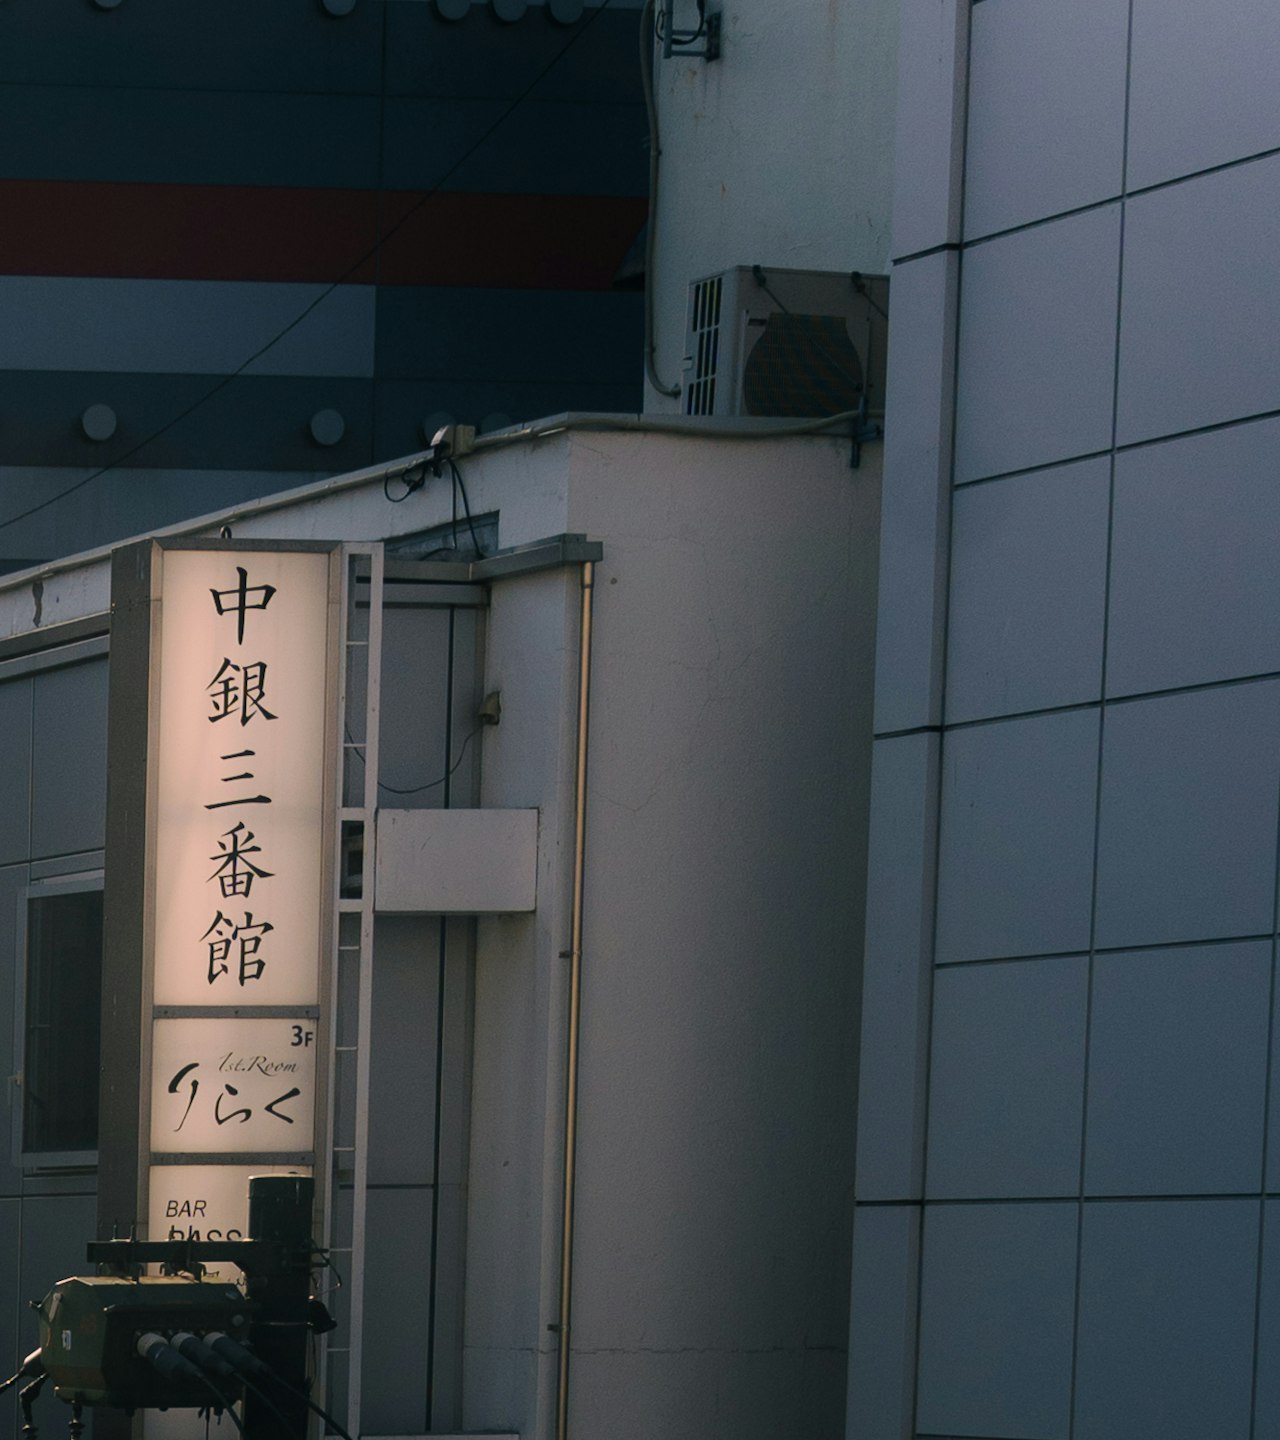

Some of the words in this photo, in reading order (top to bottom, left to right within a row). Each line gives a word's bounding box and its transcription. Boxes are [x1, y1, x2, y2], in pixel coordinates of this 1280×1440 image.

[198, 566, 280, 988] 中銀三番館
[290, 1025, 315, 1047] 3F
[166, 1200, 207, 1218] BAR
